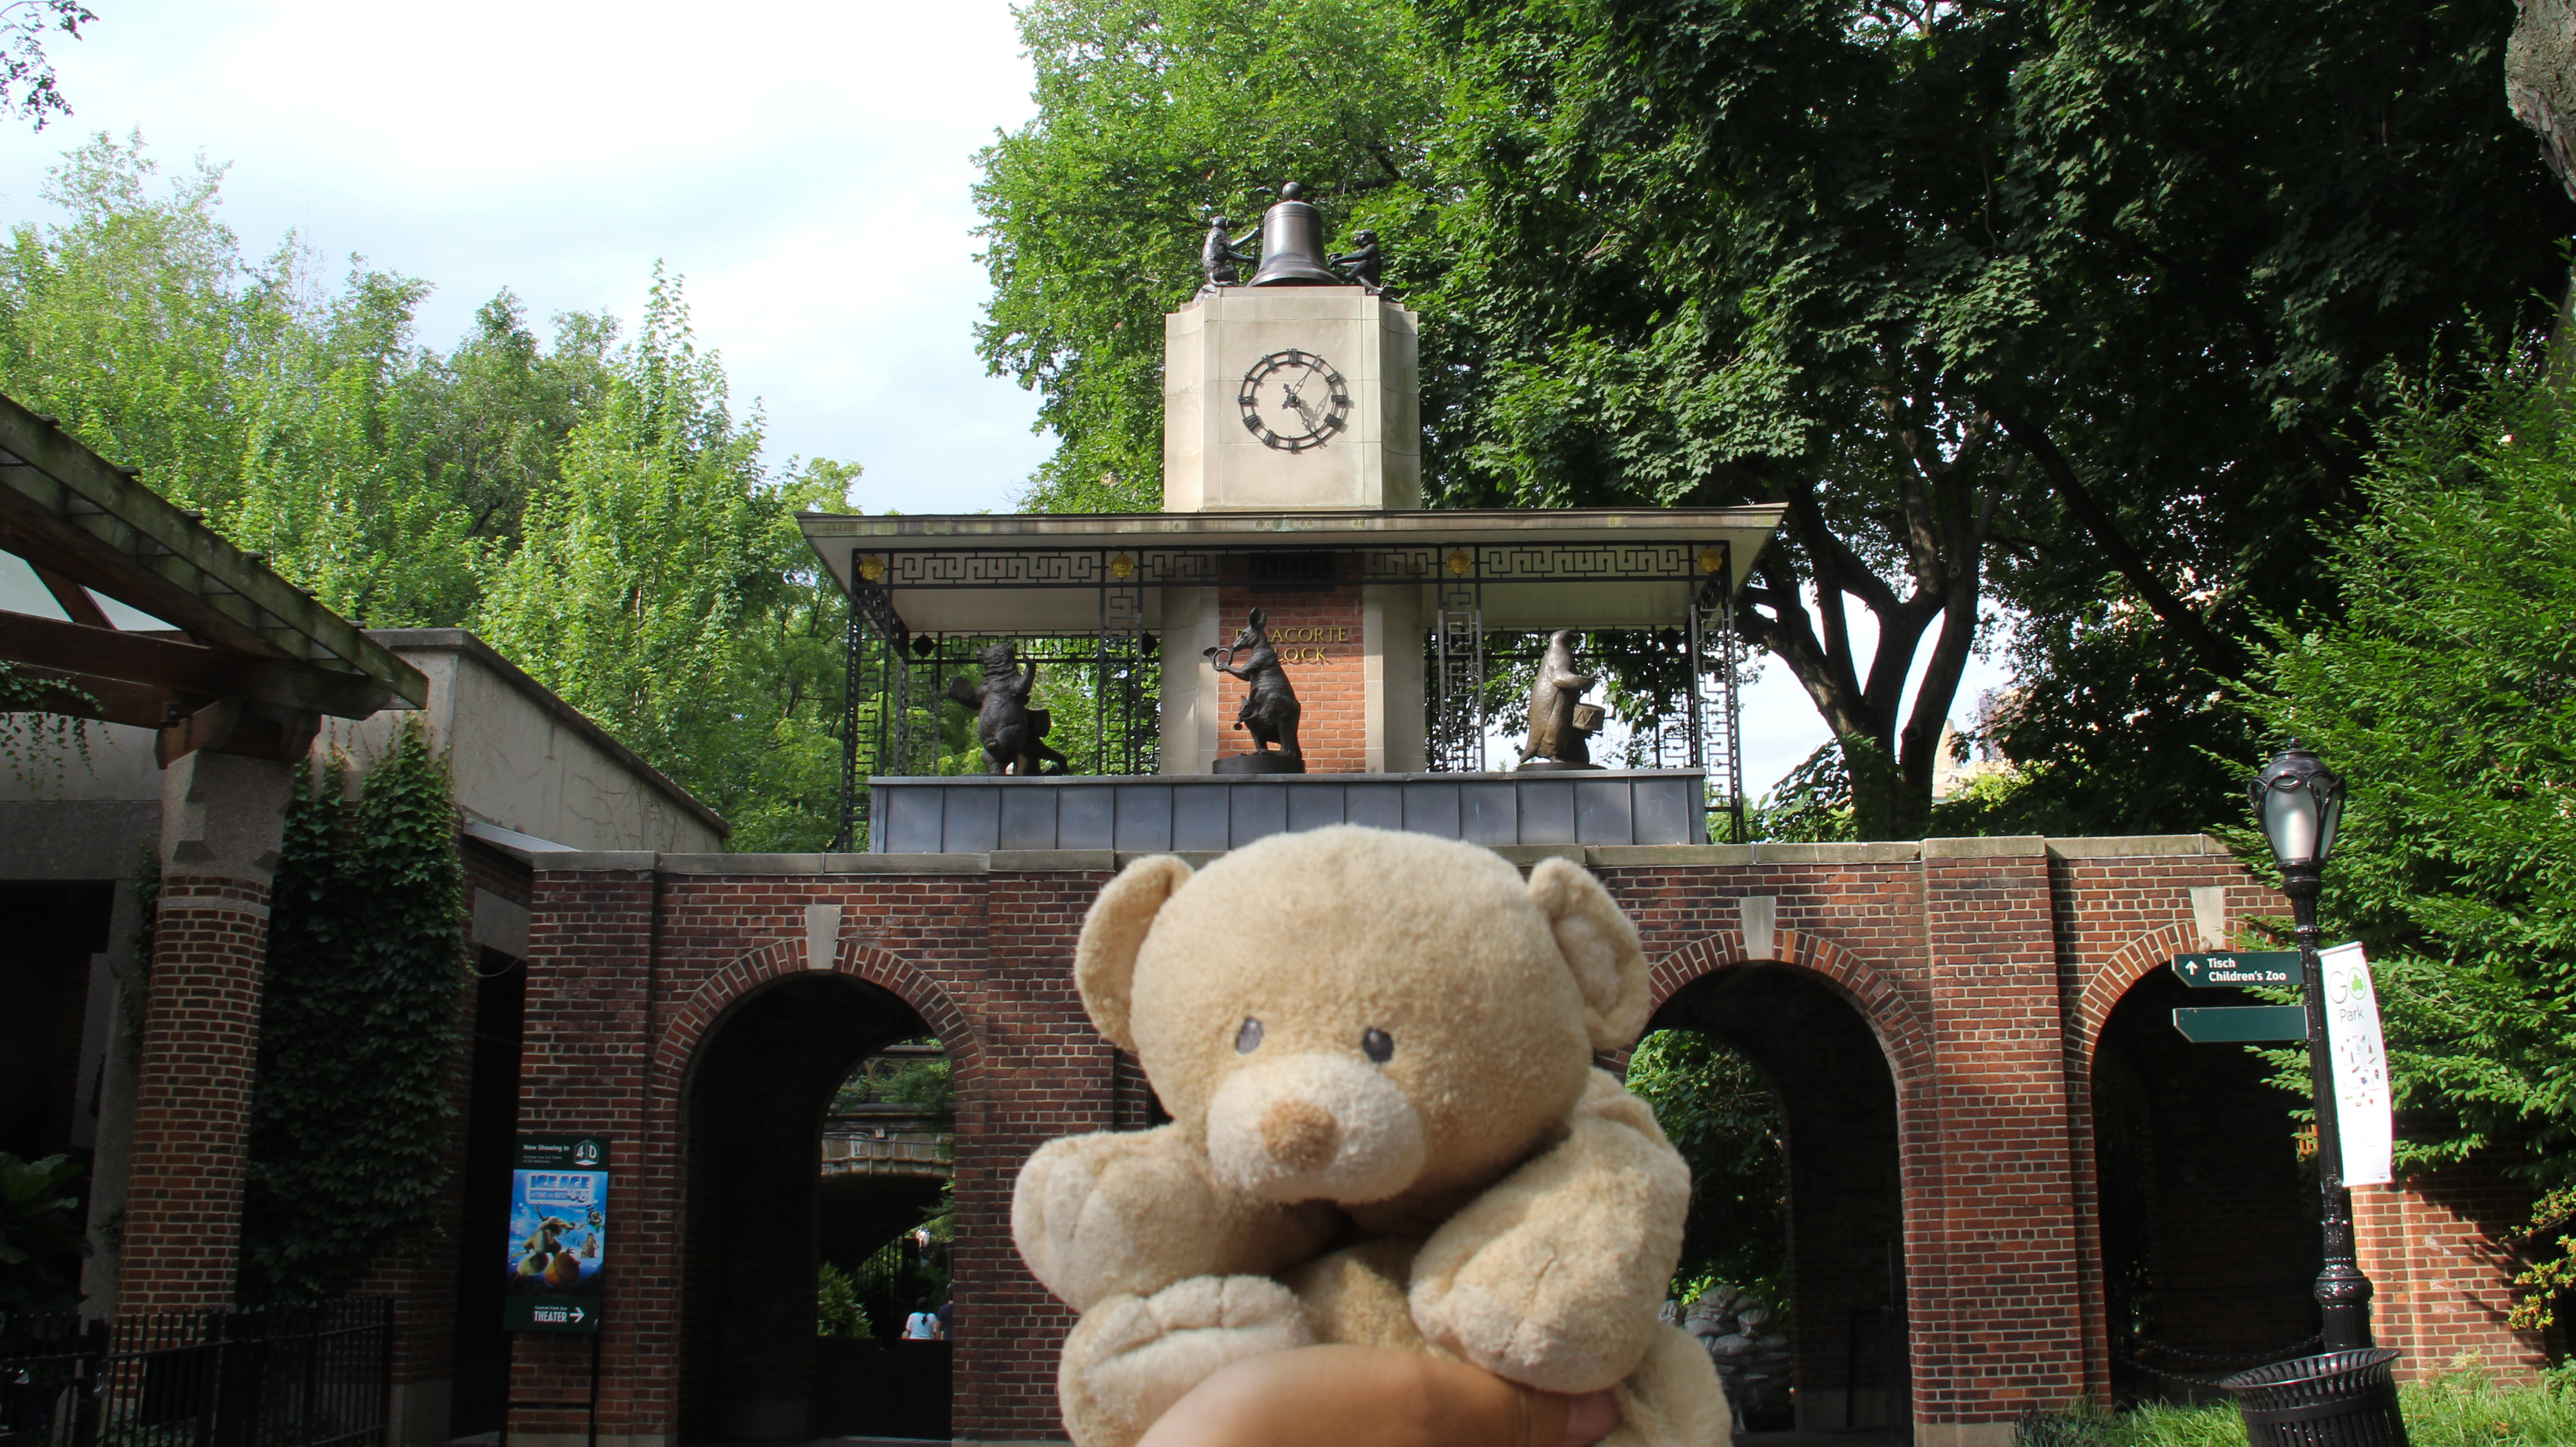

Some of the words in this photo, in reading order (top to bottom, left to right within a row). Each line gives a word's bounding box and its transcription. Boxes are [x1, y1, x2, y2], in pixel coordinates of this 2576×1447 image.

[1236, 627, 1348, 642] ACORTE
[2206, 957, 2236, 968] Tisch
[2208, 971, 2263, 982] Children's
[2265, 971, 2287, 981] Zoo
[2340, 1005, 2364, 1023] Park
[538, 1144, 563, 1153] Showing
[531, 1175, 557, 1188] ICE
[558, 1175, 590, 1189] AGE
[534, 1311, 567, 1322] THEATER
